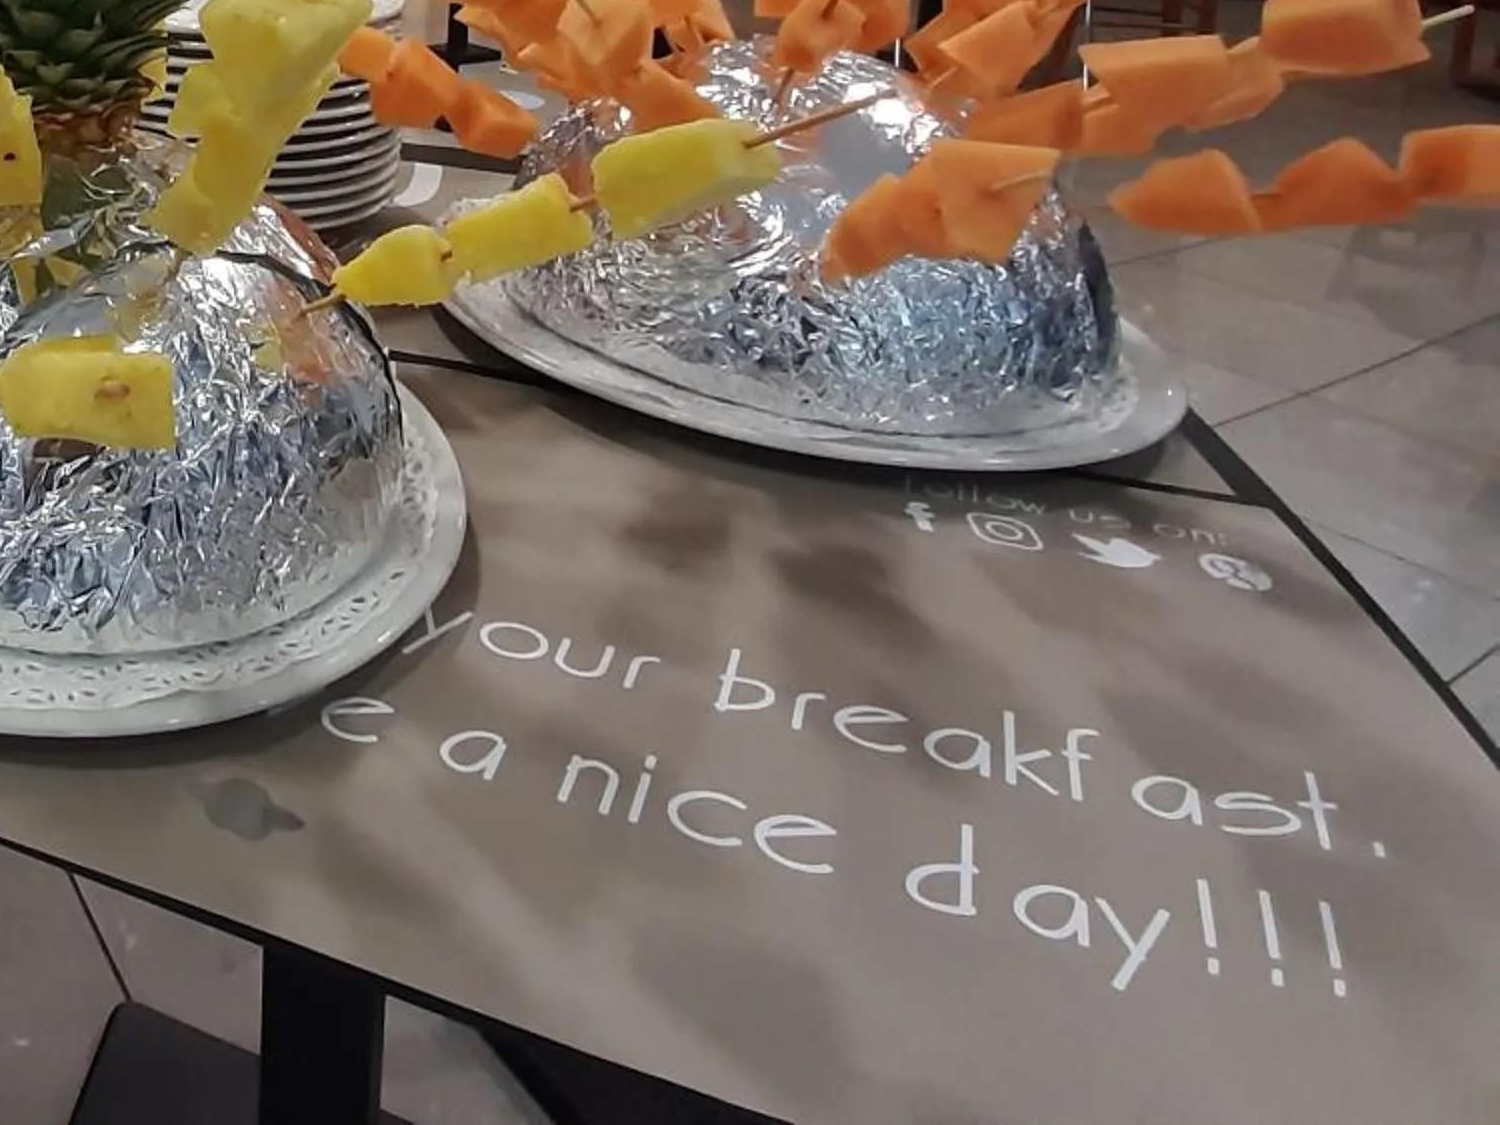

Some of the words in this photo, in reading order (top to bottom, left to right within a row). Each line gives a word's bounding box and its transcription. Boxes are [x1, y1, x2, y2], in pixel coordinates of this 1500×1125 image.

[402, 605, 661, 690] your
[439, 730, 507, 782] a
[556, 754, 839, 874] nice
[905, 823, 1348, 998] day!!!
